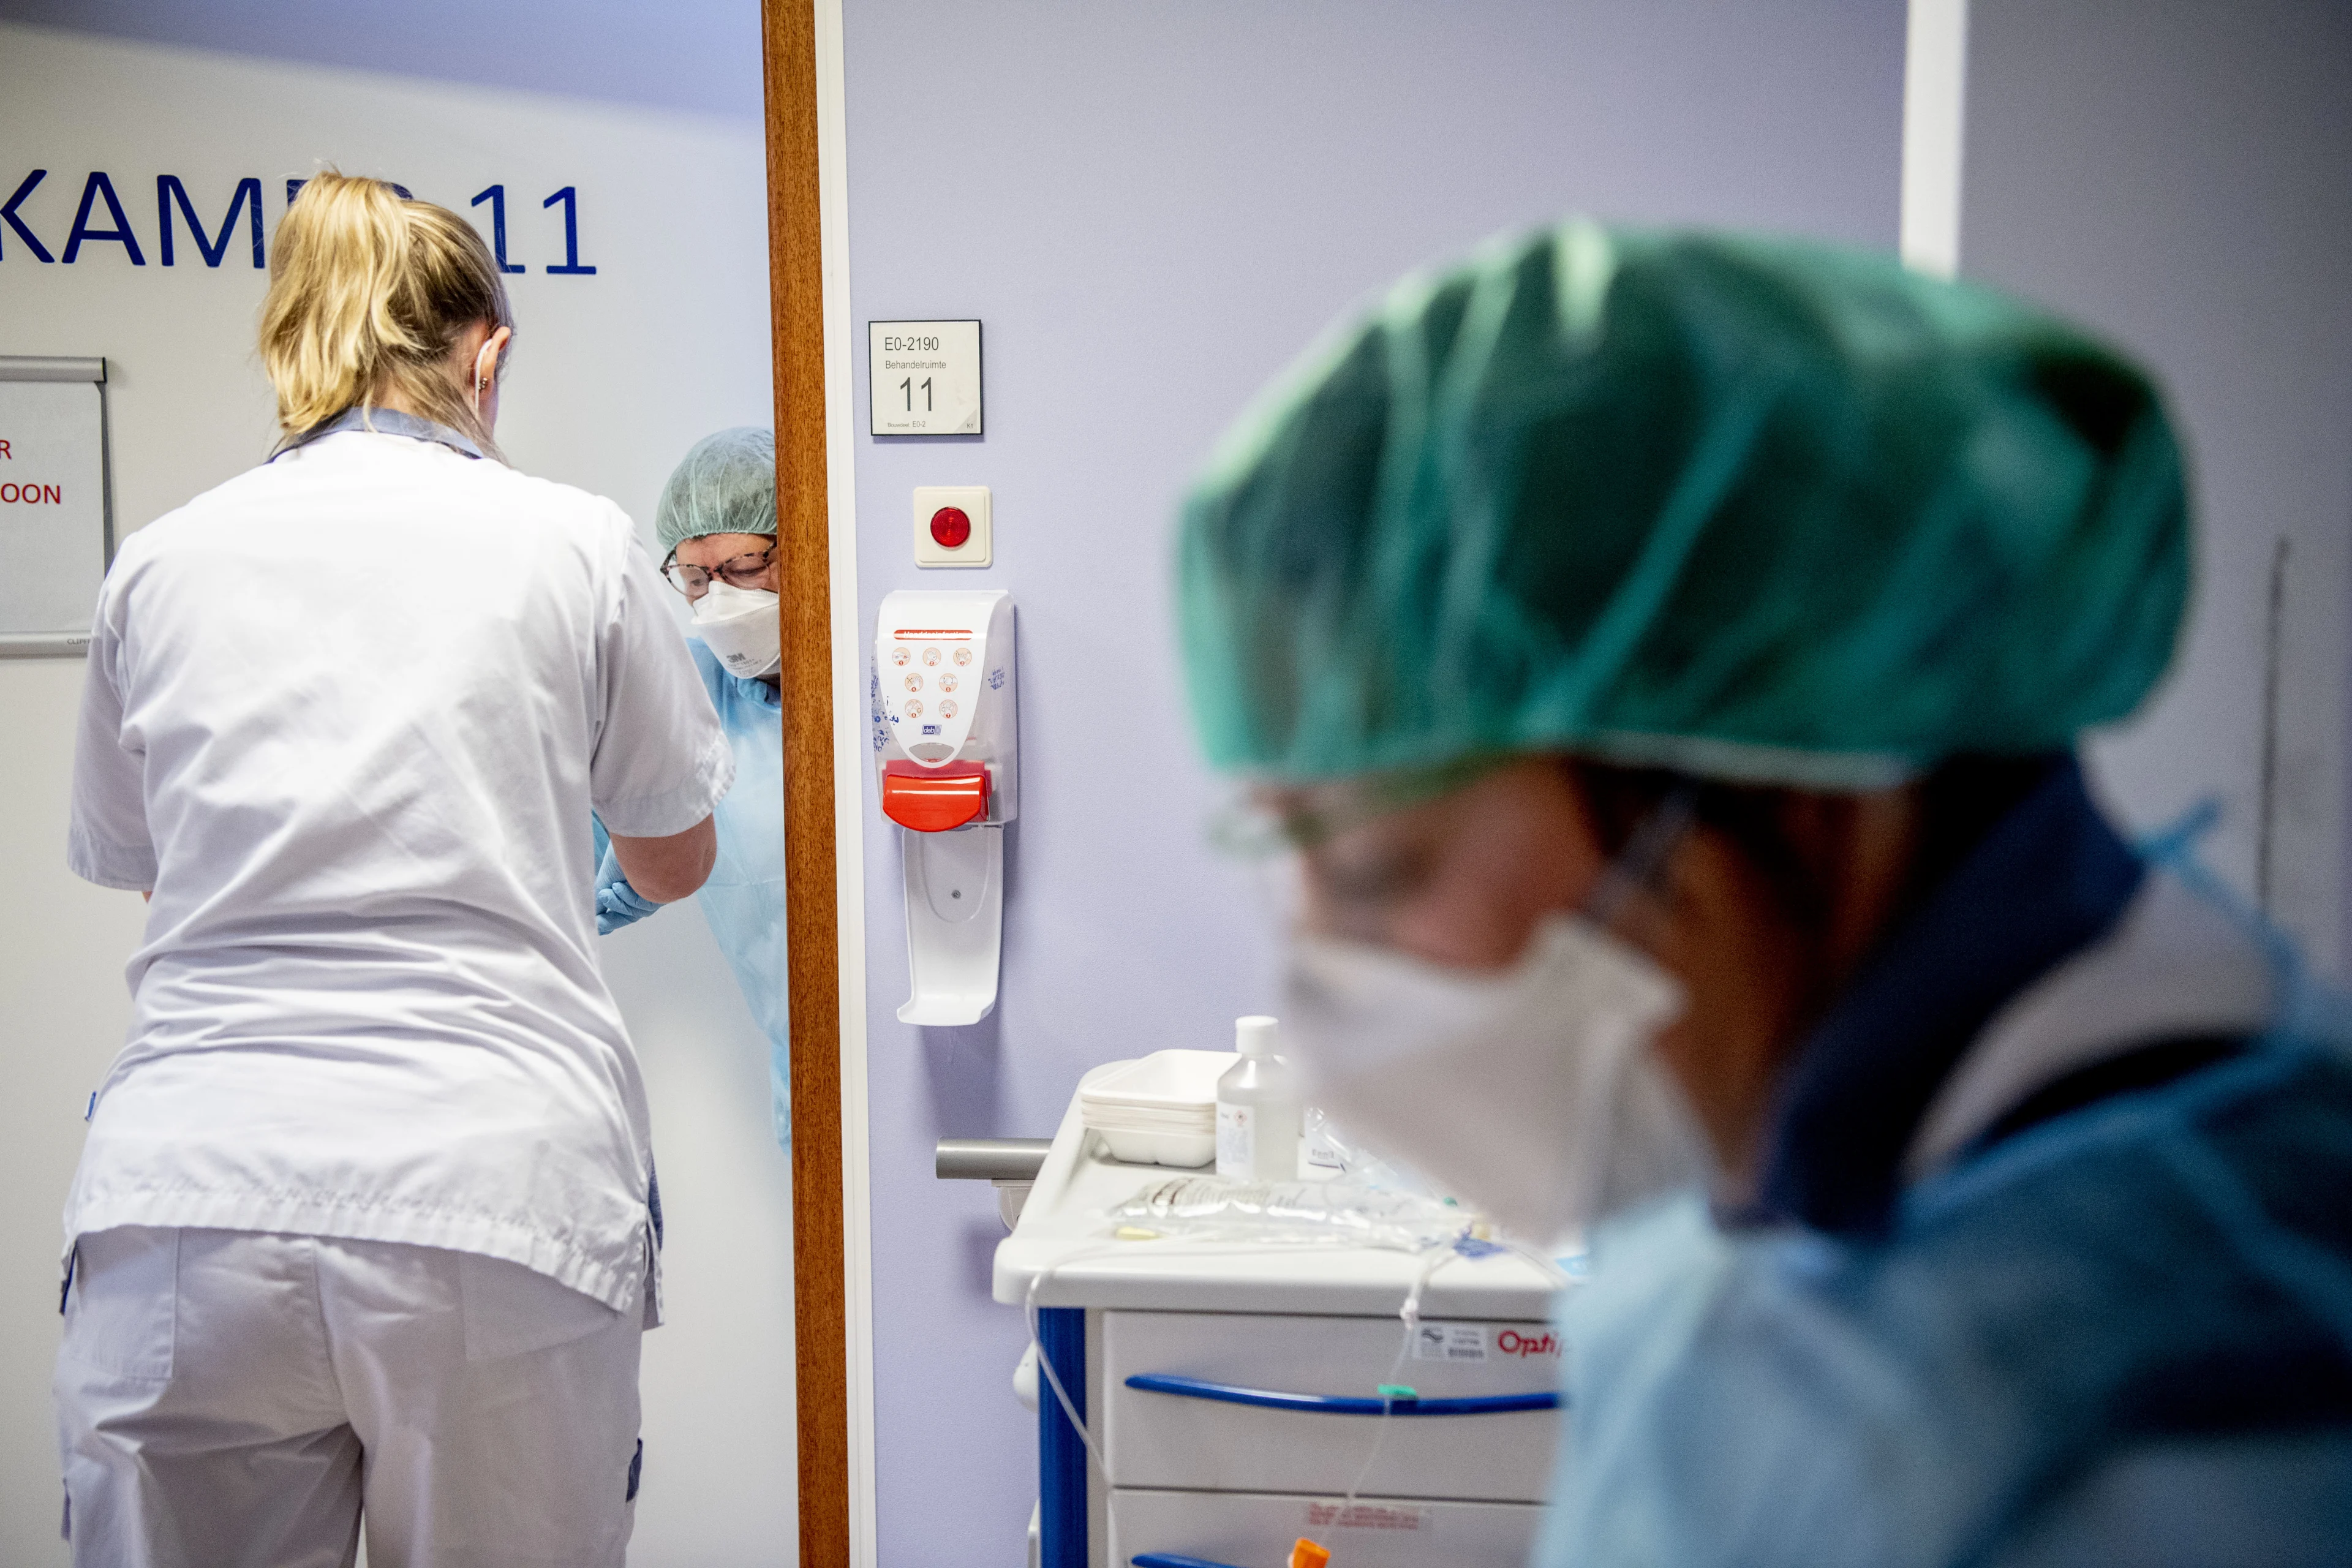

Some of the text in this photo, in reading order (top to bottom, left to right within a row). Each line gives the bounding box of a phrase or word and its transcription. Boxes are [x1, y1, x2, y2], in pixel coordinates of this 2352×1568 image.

[471, 184, 597, 274] 11
[884, 337, 939, 351] E0-2190
[885, 360, 946, 369] Behandelruimte
[900, 377, 932, 412] 11
[0, 483, 61, 504] OON
[726, 652, 746, 663] 3M
